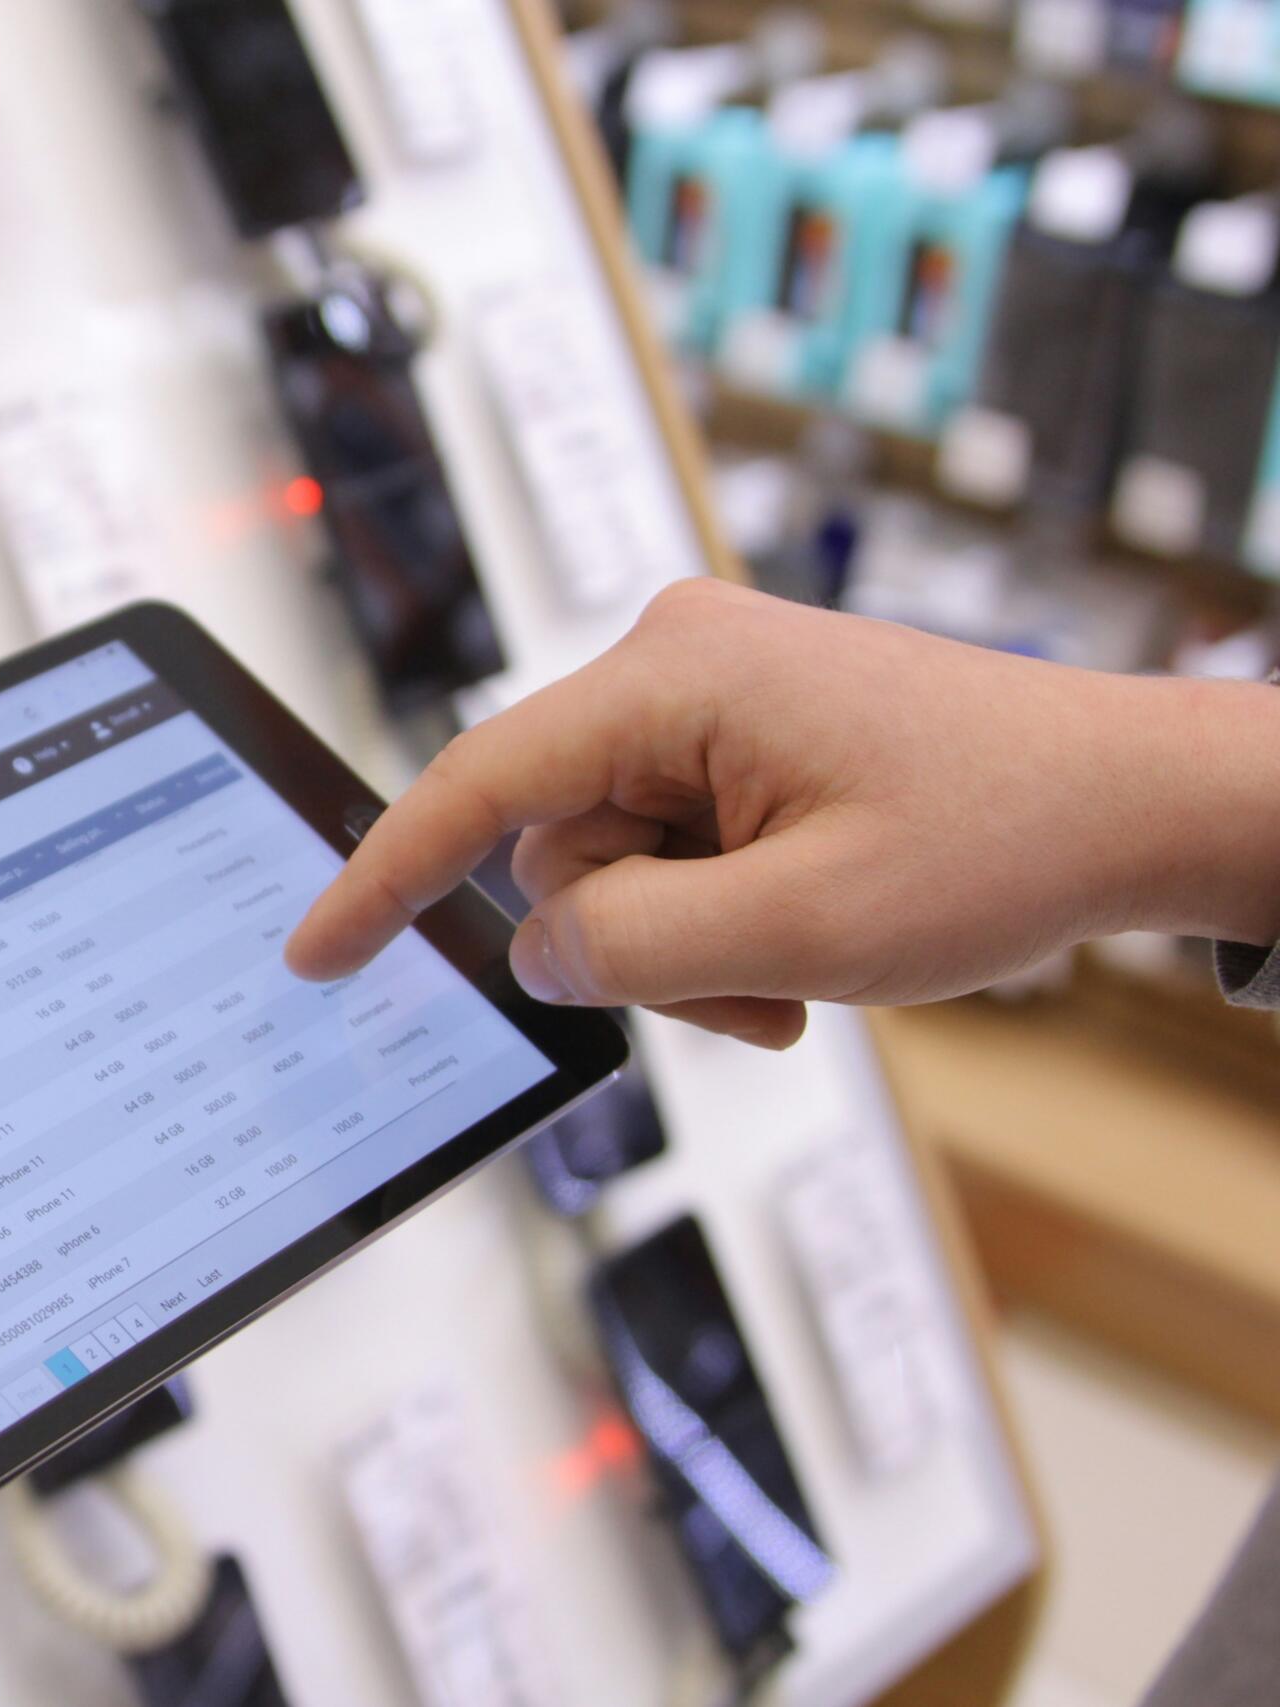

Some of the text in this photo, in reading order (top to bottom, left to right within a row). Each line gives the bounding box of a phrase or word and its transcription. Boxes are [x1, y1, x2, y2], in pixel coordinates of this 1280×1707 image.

[6, 974, 27, 990] 512
[25, 966, 42, 979] GB
[35, 1008, 51, 1019] 16
[49, 1000, 66, 1012] GB
[65, 1038, 80, 1051] 64
[78, 1030, 95, 1043] GB
[0, 1123, 15, 1135] 11
[94, 1069, 109, 1082] 64
[107, 1061, 125, 1074] GB
[29, 1155, 45, 1168] 11
[124, 1100, 139, 1113] 64
[137, 1092, 155, 1105] GB
[26, 1198, 62, 1222] iPhone
[60, 1188, 75, 1200] 11
[154, 1132, 169, 1145] 64
[167, 1123, 185, 1136] GB
[57, 1232, 92, 1256] iphone
[90, 1225, 101, 1235] 6
[184, 1164, 200, 1176] 16
[198, 1154, 215, 1168] GB
[88, 1265, 124, 1289] iPhone
[121, 1256, 131, 1268] 7
[214, 1196, 230, 1209] 32
[228, 1186, 246, 1200] GB
[197, 1269, 222, 1288] Last
[160, 1292, 187, 1311] Next
[134, 1318, 143, 1328] 4
[109, 1333, 121, 1344] 3
[85, 1348, 98, 1360] 2
